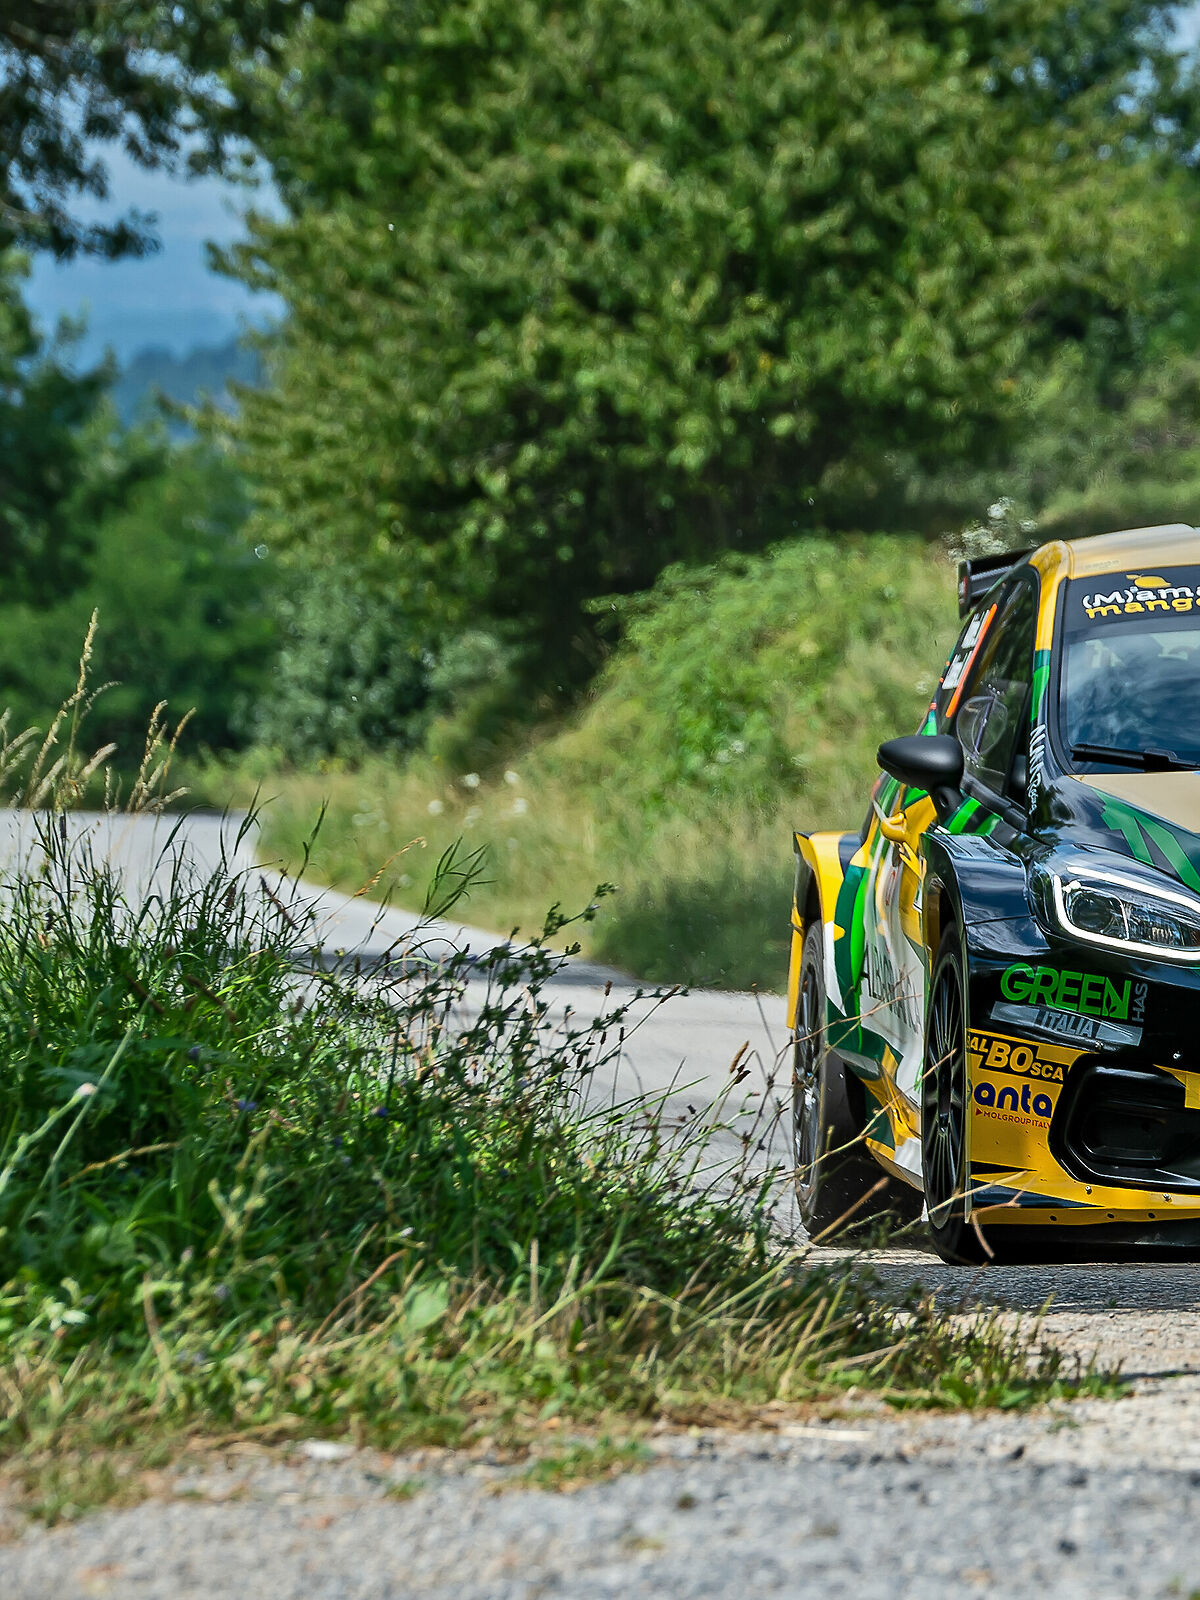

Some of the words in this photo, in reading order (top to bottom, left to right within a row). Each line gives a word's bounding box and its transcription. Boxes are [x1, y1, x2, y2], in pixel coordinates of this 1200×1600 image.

[1001, 962, 1132, 1020] GREEN
[1132, 982, 1148, 1022] HAS
[1041, 1011, 1094, 1038] ITALIA
[968, 1036, 1064, 1081] ALBOSCA
[967, 1079, 1053, 1119] anta
